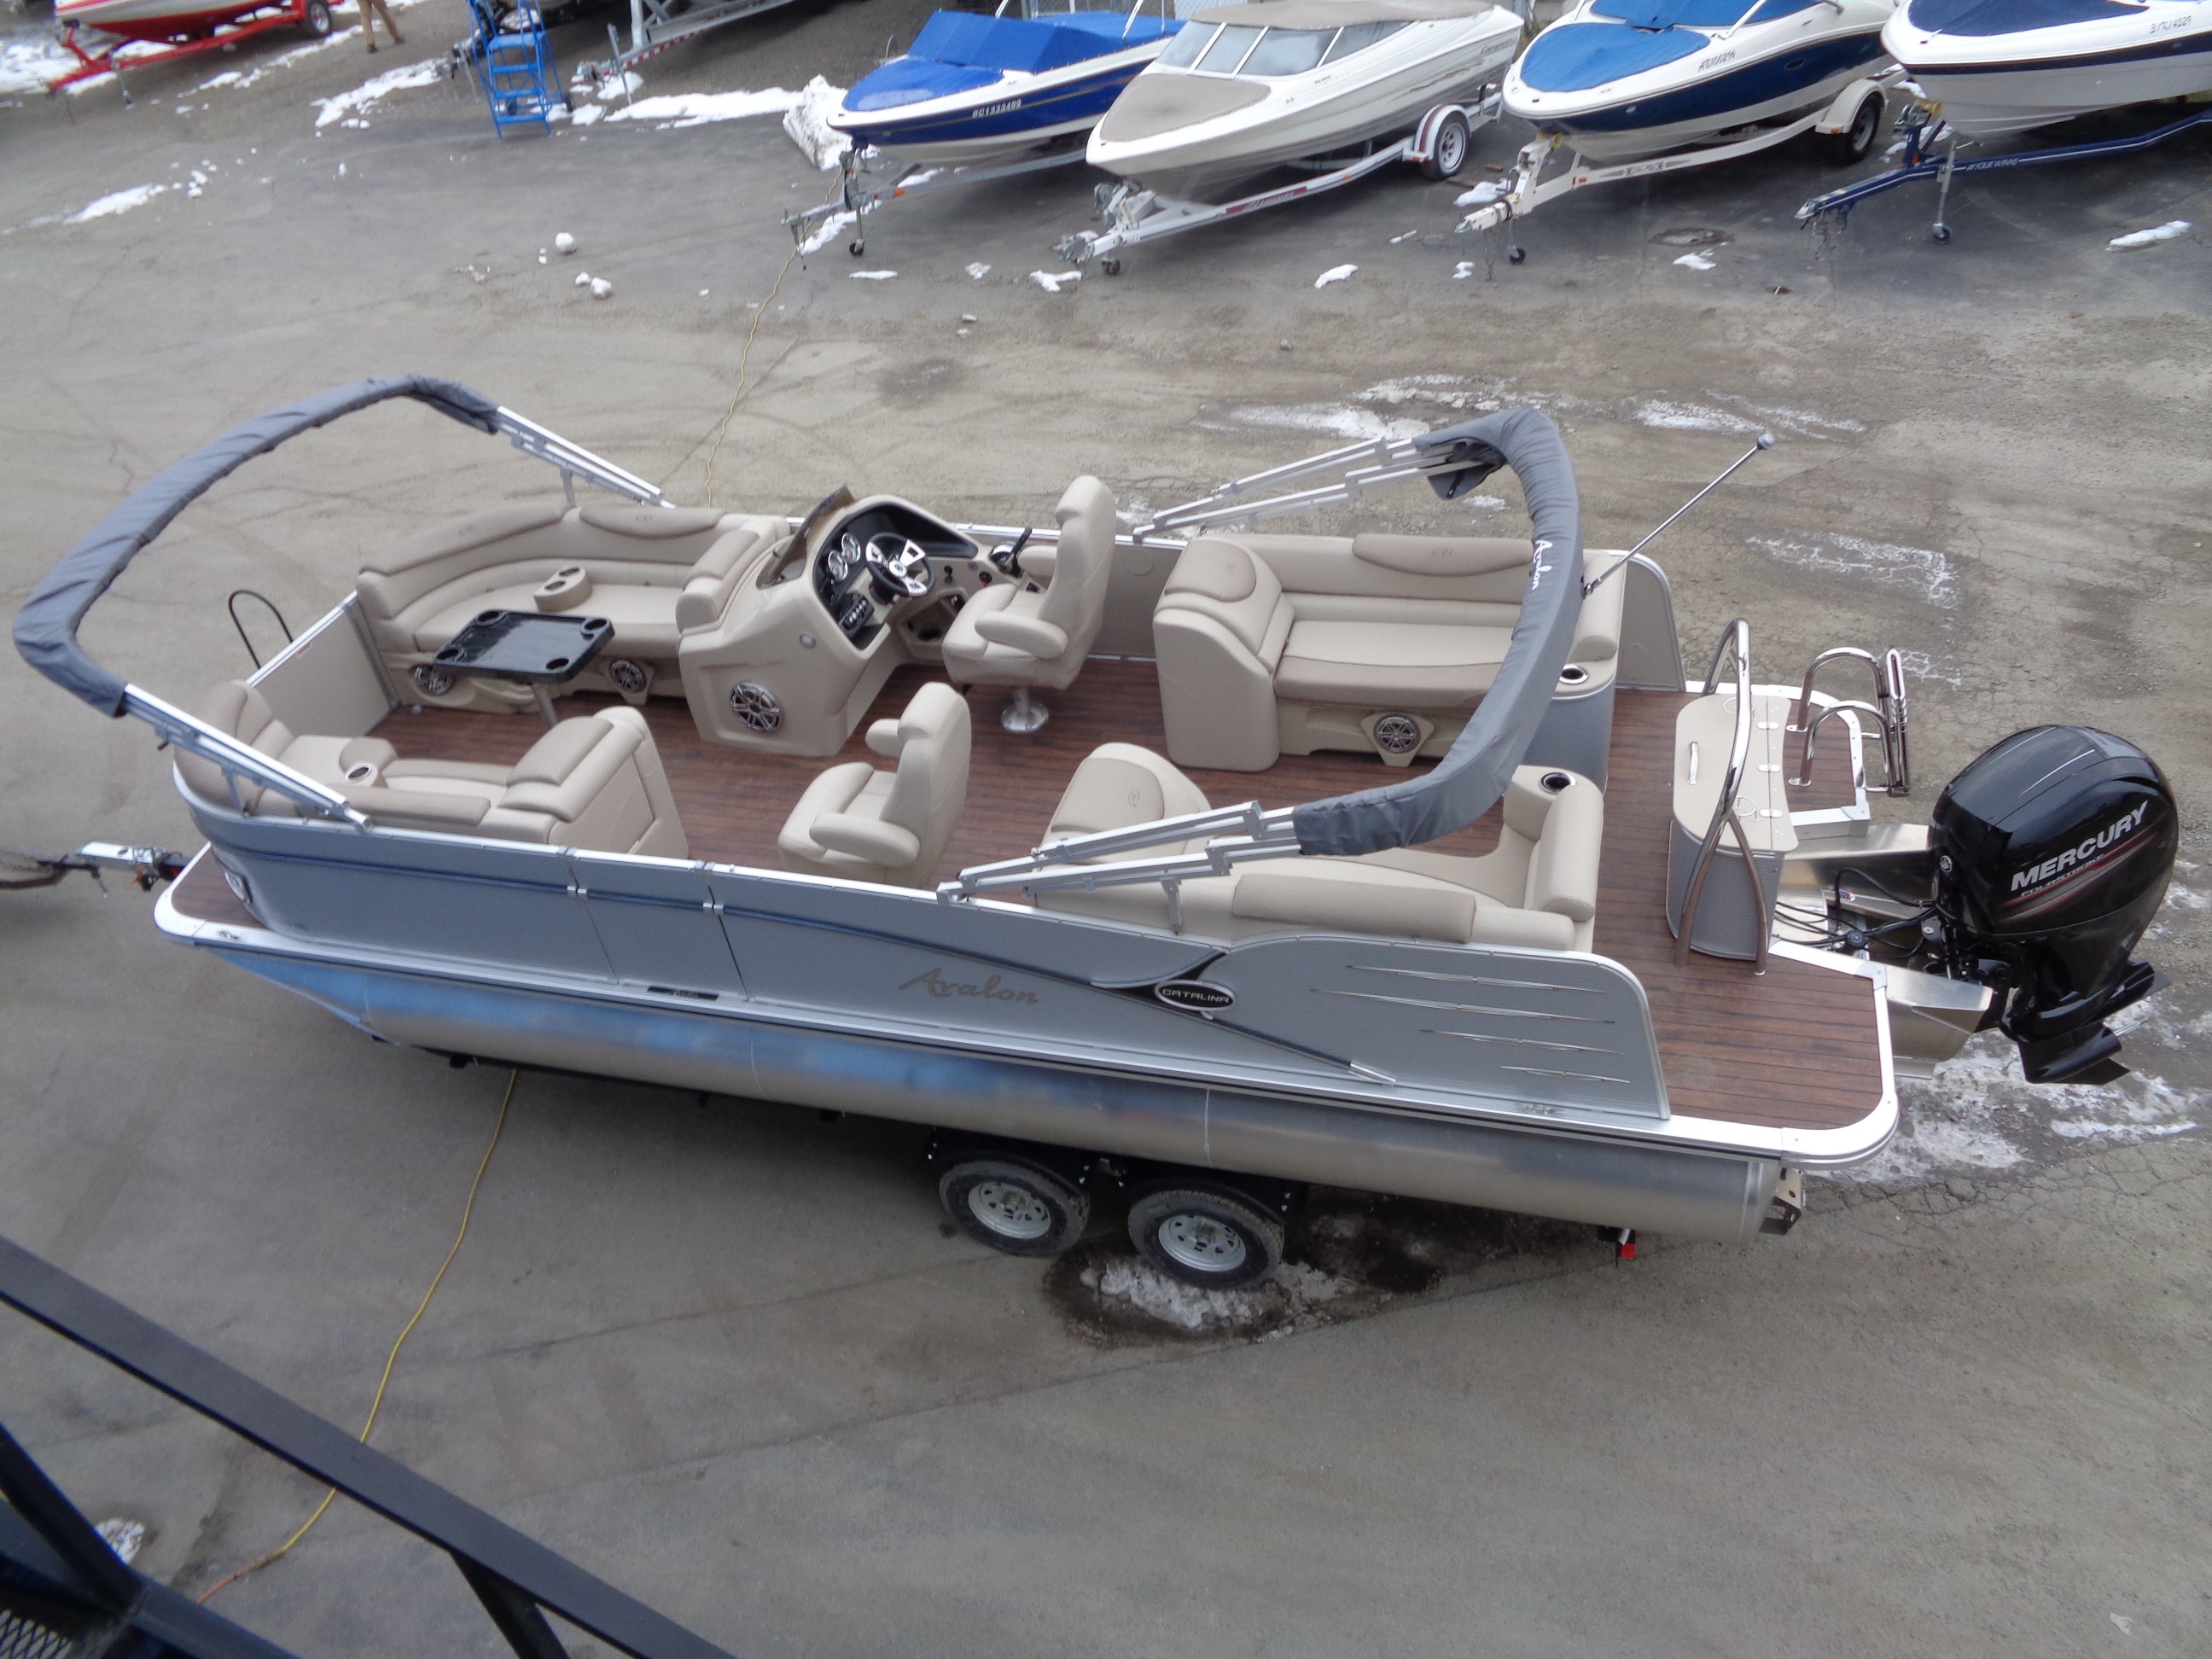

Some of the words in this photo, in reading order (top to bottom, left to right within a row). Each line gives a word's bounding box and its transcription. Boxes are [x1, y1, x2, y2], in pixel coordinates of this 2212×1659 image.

[1532, 539, 1552, 591] Avalon
[2011, 800, 2148, 892] MERCURY
[898, 968, 1039, 1004] Avalon
[1161, 988, 1230, 1004] CATALINA
